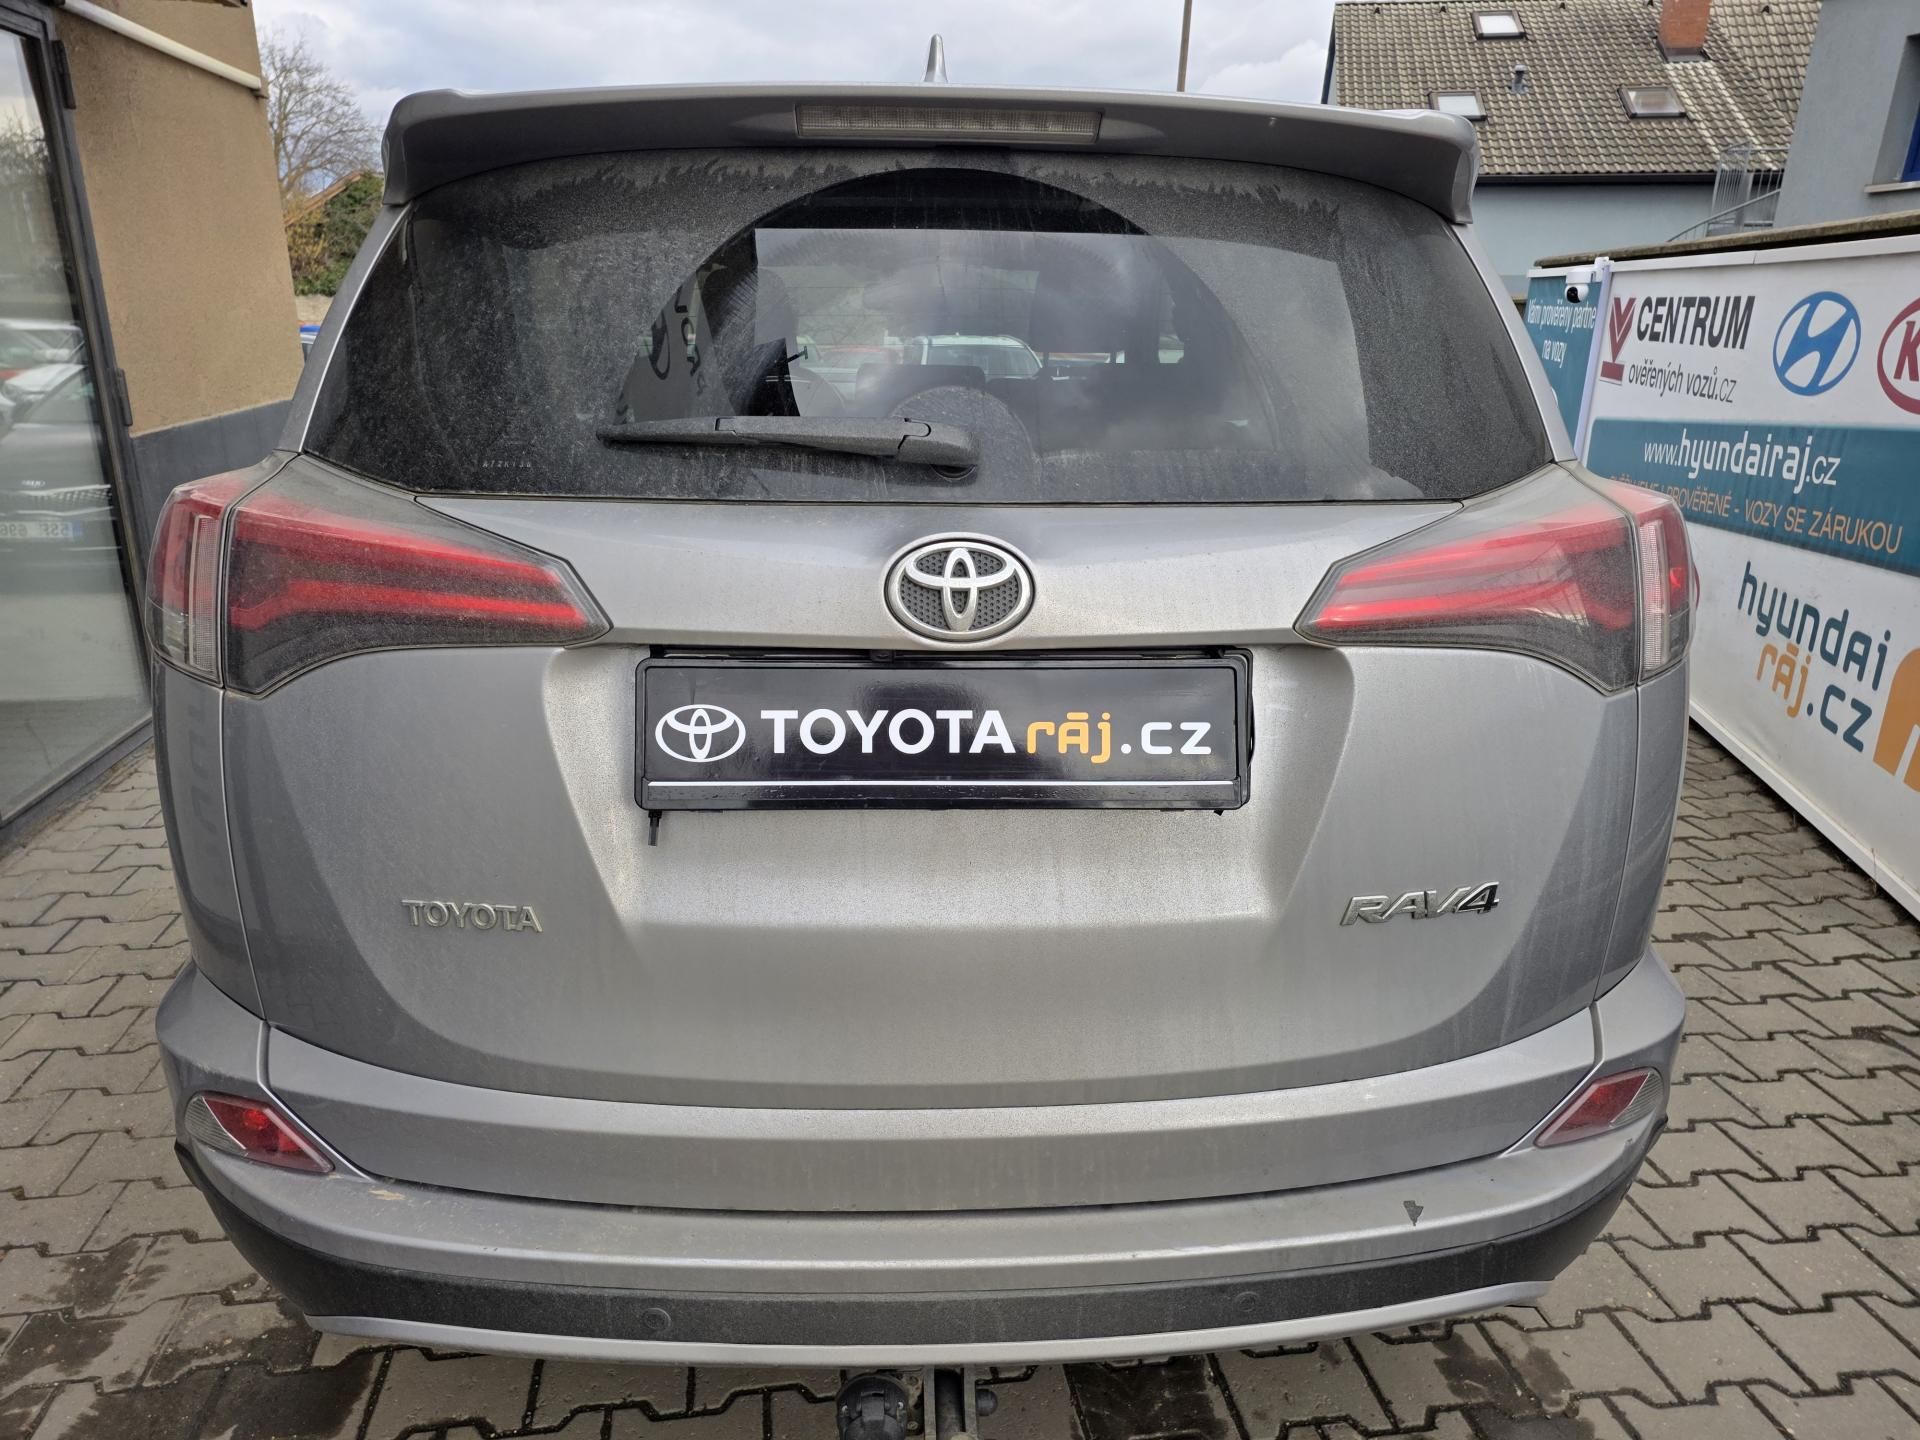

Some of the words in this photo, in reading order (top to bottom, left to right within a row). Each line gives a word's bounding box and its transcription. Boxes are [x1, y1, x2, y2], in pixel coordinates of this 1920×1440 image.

[1571, 302, 1597, 329] partne
[1637, 296, 1755, 350] CENTRUM
[1542, 340, 1551, 360] na
[1551, 341, 1567, 369] vozy
[1628, 358, 1685, 397] ověřených
[1686, 366, 1737, 403] vozů.cz
[1644, 428, 1841, 494] www.hyundairaj.cz
[1745, 498, 1782, 528] VOZY
[1784, 506, 1805, 533] SE
[1808, 507, 1903, 554] ZÁRUKOU
[401, 899, 543, 933] TOYOTA
[1339, 881, 1500, 926] RAV4
